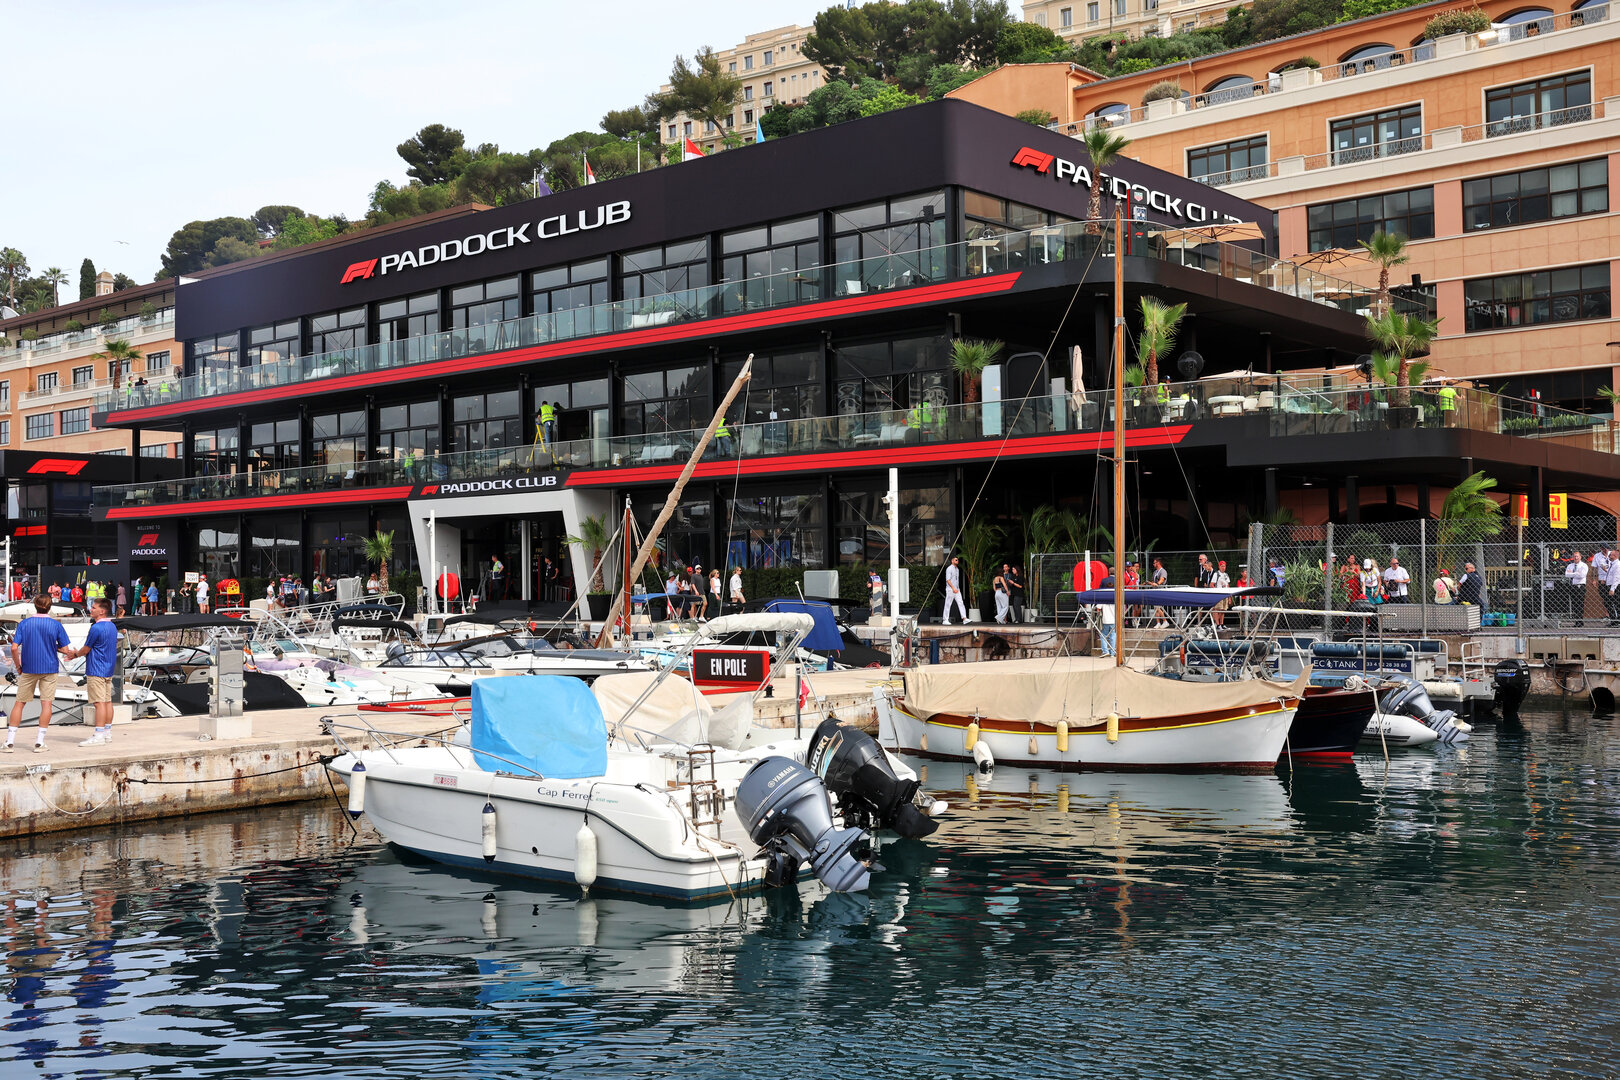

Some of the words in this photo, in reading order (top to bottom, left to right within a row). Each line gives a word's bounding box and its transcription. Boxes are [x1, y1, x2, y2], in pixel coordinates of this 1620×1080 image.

[381, 222, 531, 275] PADDOCK
[537, 200, 631, 239] CLUB
[441, 479, 513, 494] PADDOCK
[515, 476, 557, 488] CLUB
[131, 548, 166, 556] PADDOCK
[710, 658, 722, 676] EN
[724, 658, 747, 677] POLE
[772, 765, 796, 783] YAMAHA
[537, 786, 558, 798] Cap
[562, 789, 595, 801] Ferret
